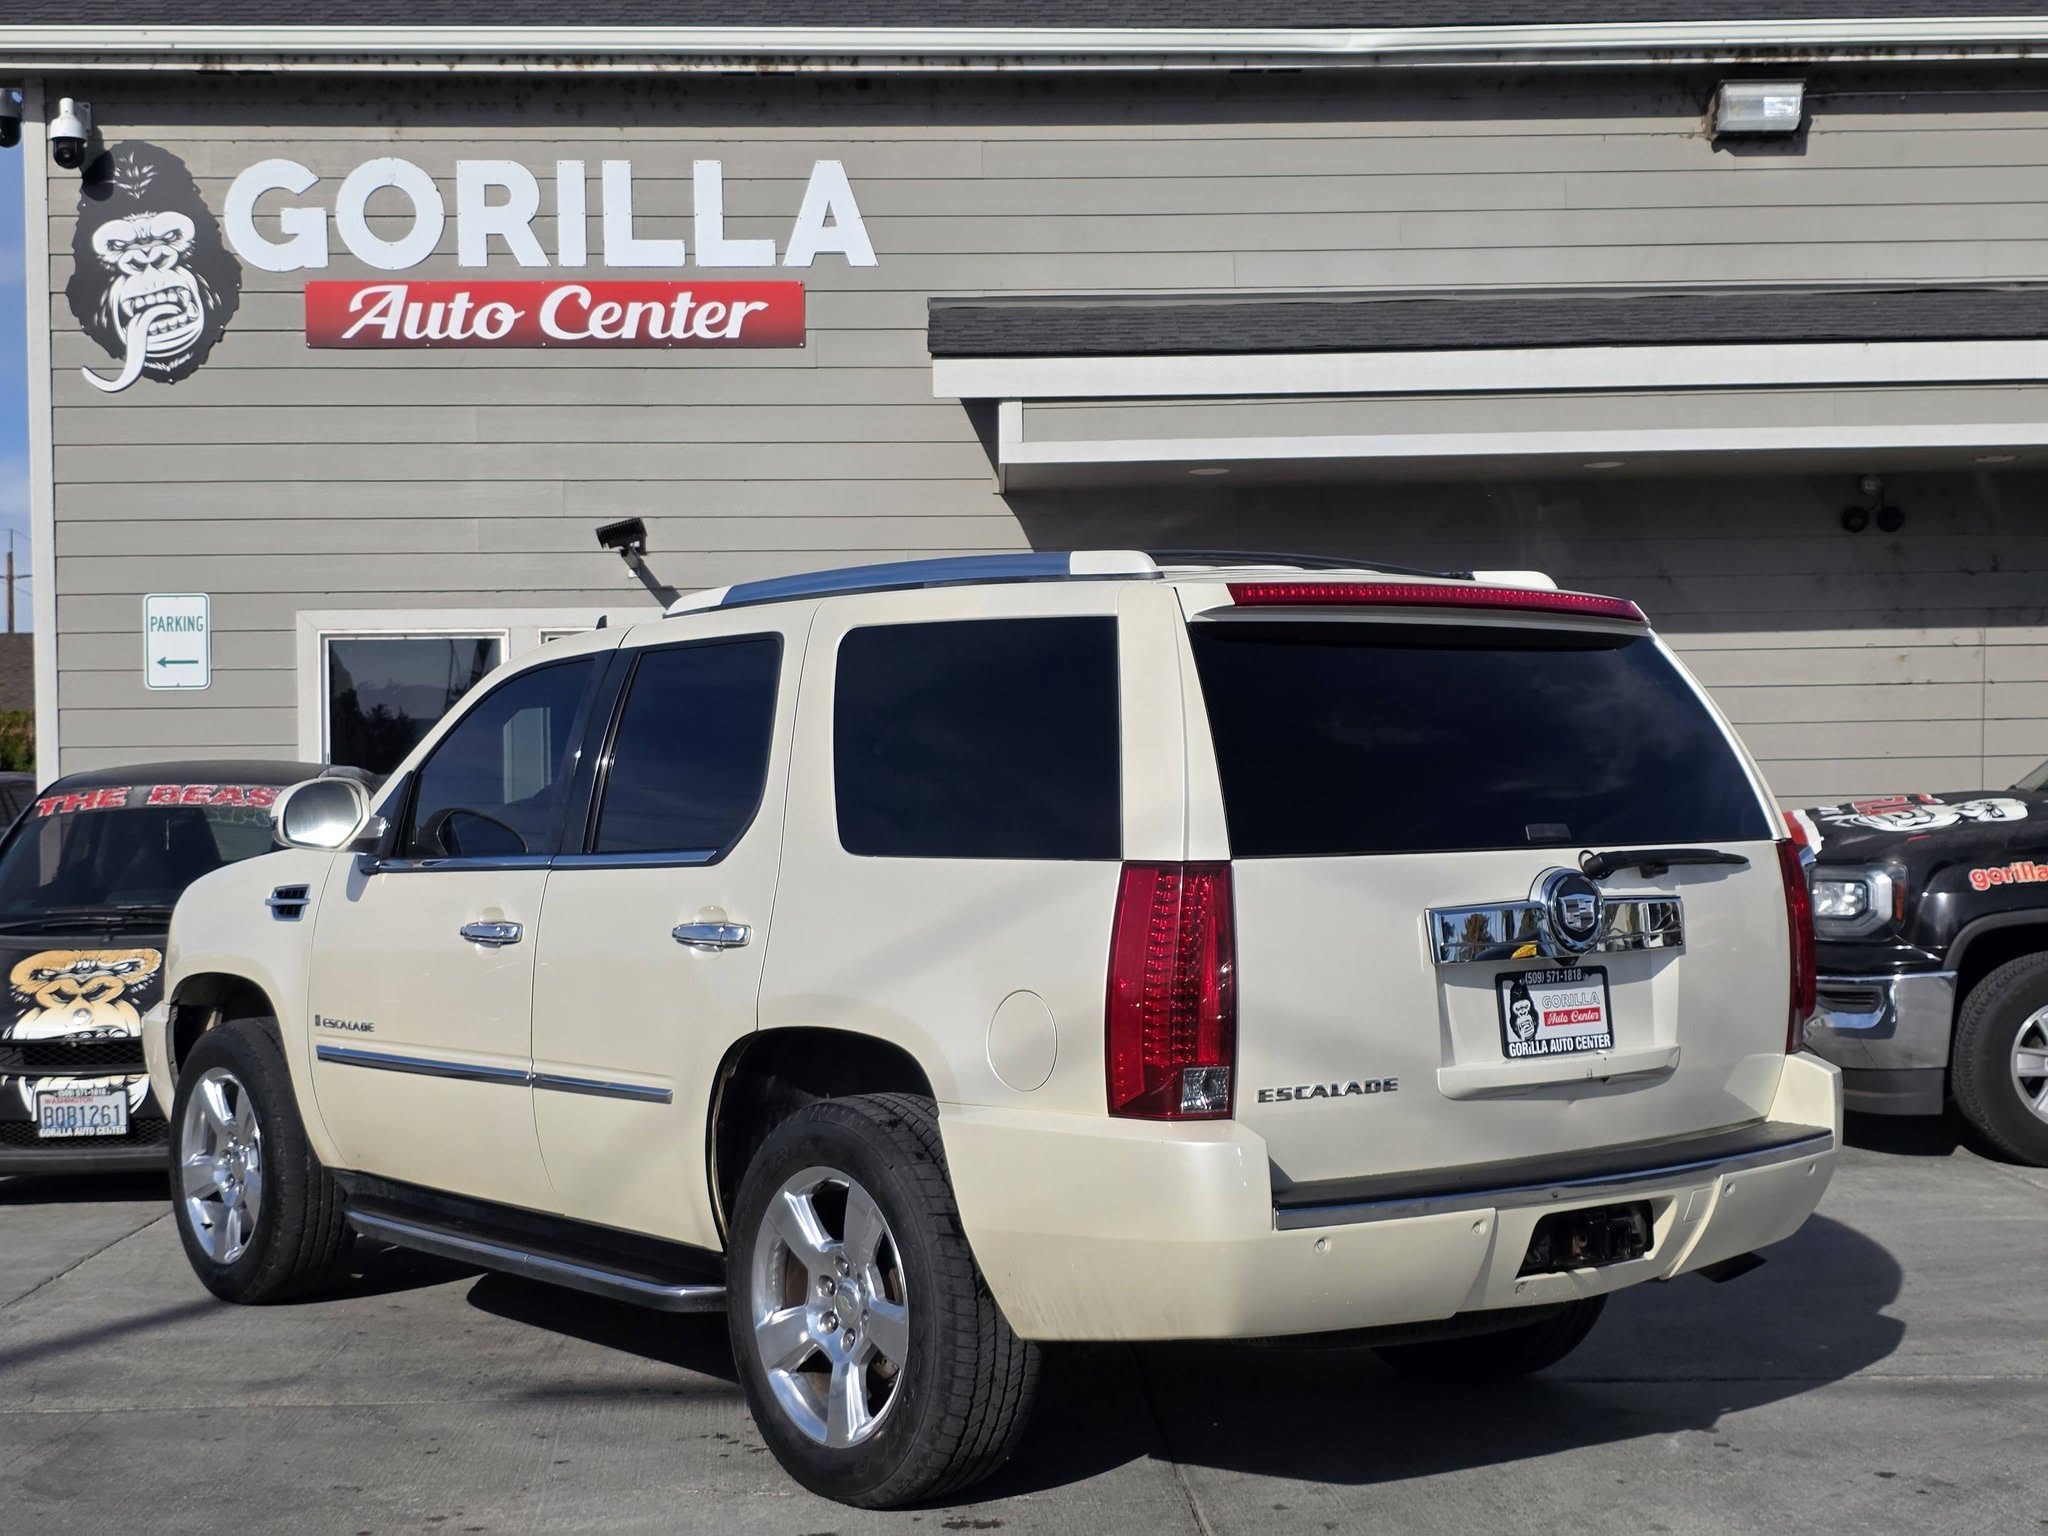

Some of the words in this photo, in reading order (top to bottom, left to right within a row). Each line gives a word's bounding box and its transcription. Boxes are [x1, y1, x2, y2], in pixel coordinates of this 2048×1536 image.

[224, 157, 880, 272] GORILLA
[341, 284, 526, 341] Auto
[538, 284, 769, 341] Center
[150, 615, 204, 633] PARKING
[35, 785, 132, 818] THE
[1524, 971, 1545, 985] (509)
[1546, 968, 1582, 982] 571-1818
[1541, 991, 1600, 1009] GORILLA
[322, 1018, 375, 1032] ESCALADE
[1547, 1013, 1569, 1025] Auto
[1570, 1009, 1600, 1023] Center
[1550, 1036, 1574, 1054] AUTO
[1576, 1034, 1611, 1050] CENTER
[1257, 1077, 1399, 1103] ESCALADE
[74, 1126, 95, 1136] AUTO
[95, 1125, 127, 1135] CENTER
